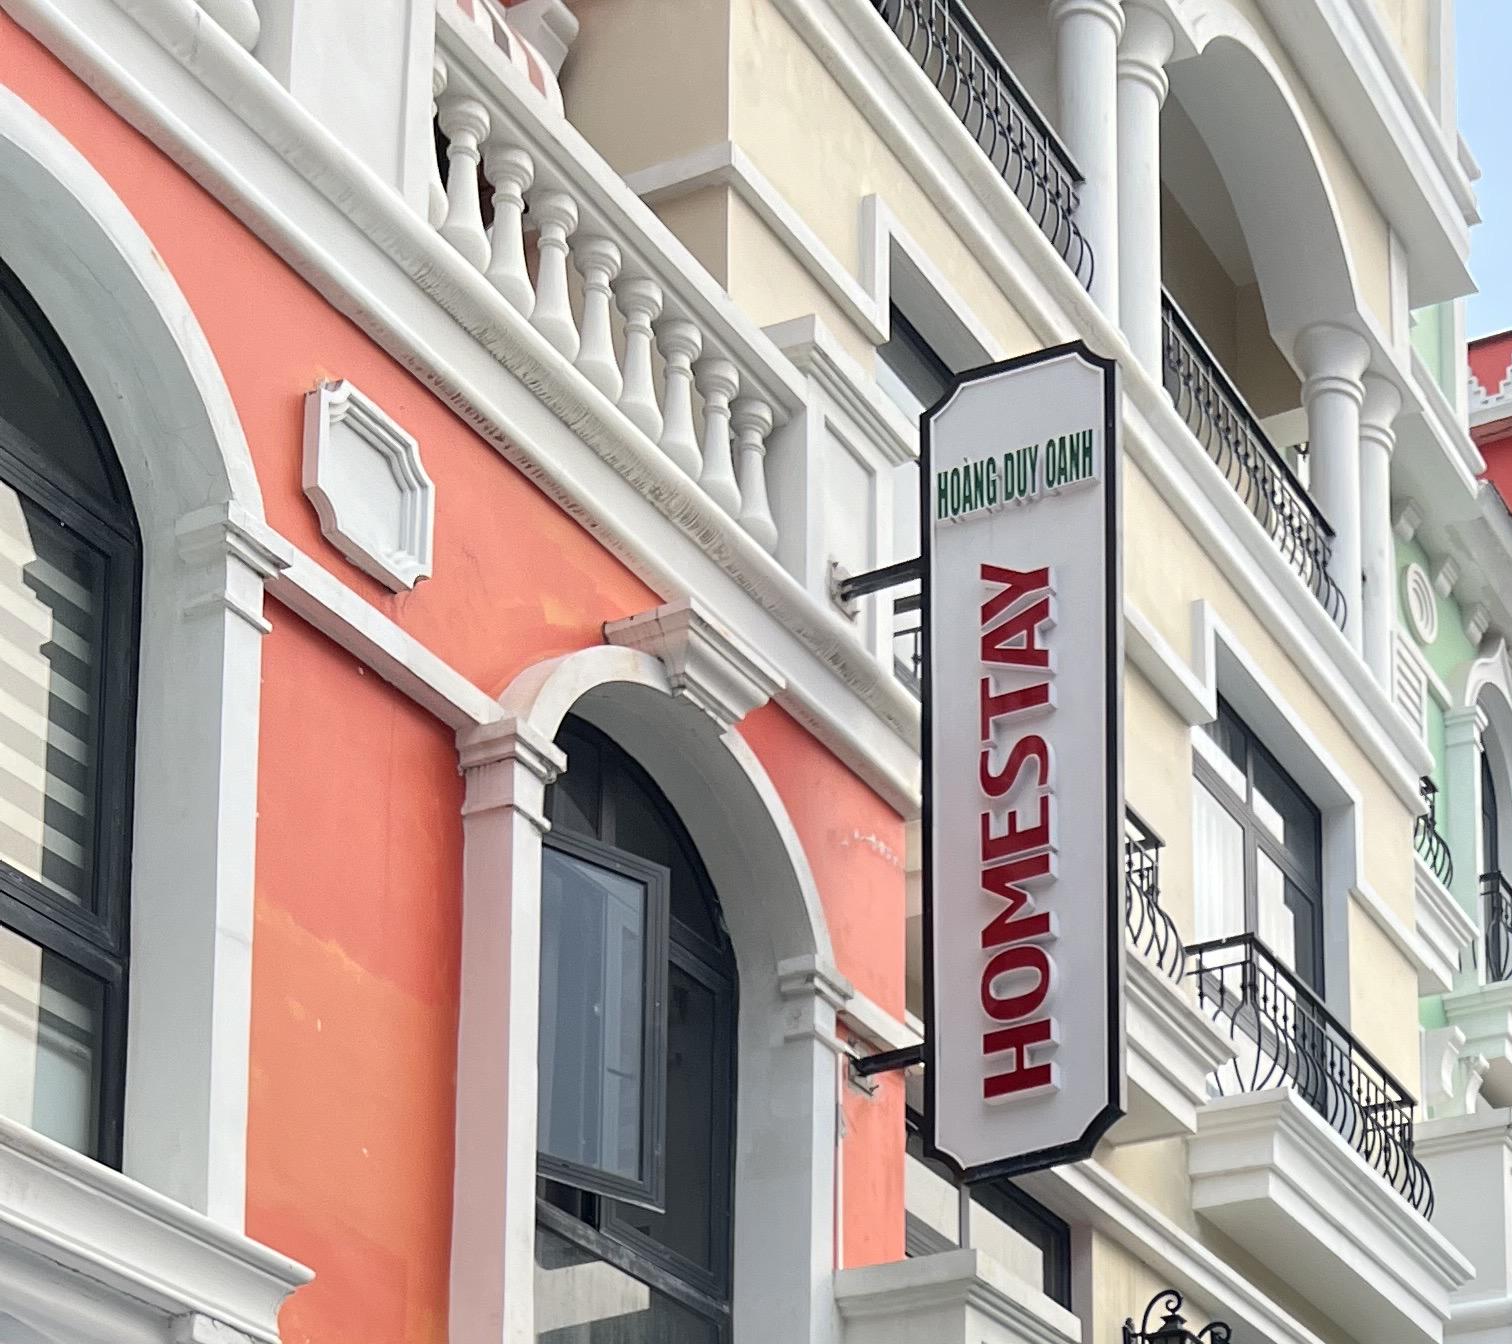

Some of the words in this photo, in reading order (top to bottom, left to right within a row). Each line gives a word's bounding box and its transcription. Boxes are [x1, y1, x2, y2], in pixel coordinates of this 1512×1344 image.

[936, 455, 999, 521] HOÀNG
[1003, 444, 1040, 500] DUY
[1045, 427, 1095, 488] OANH
[980, 562, 1052, 1100] HOMESTAY
